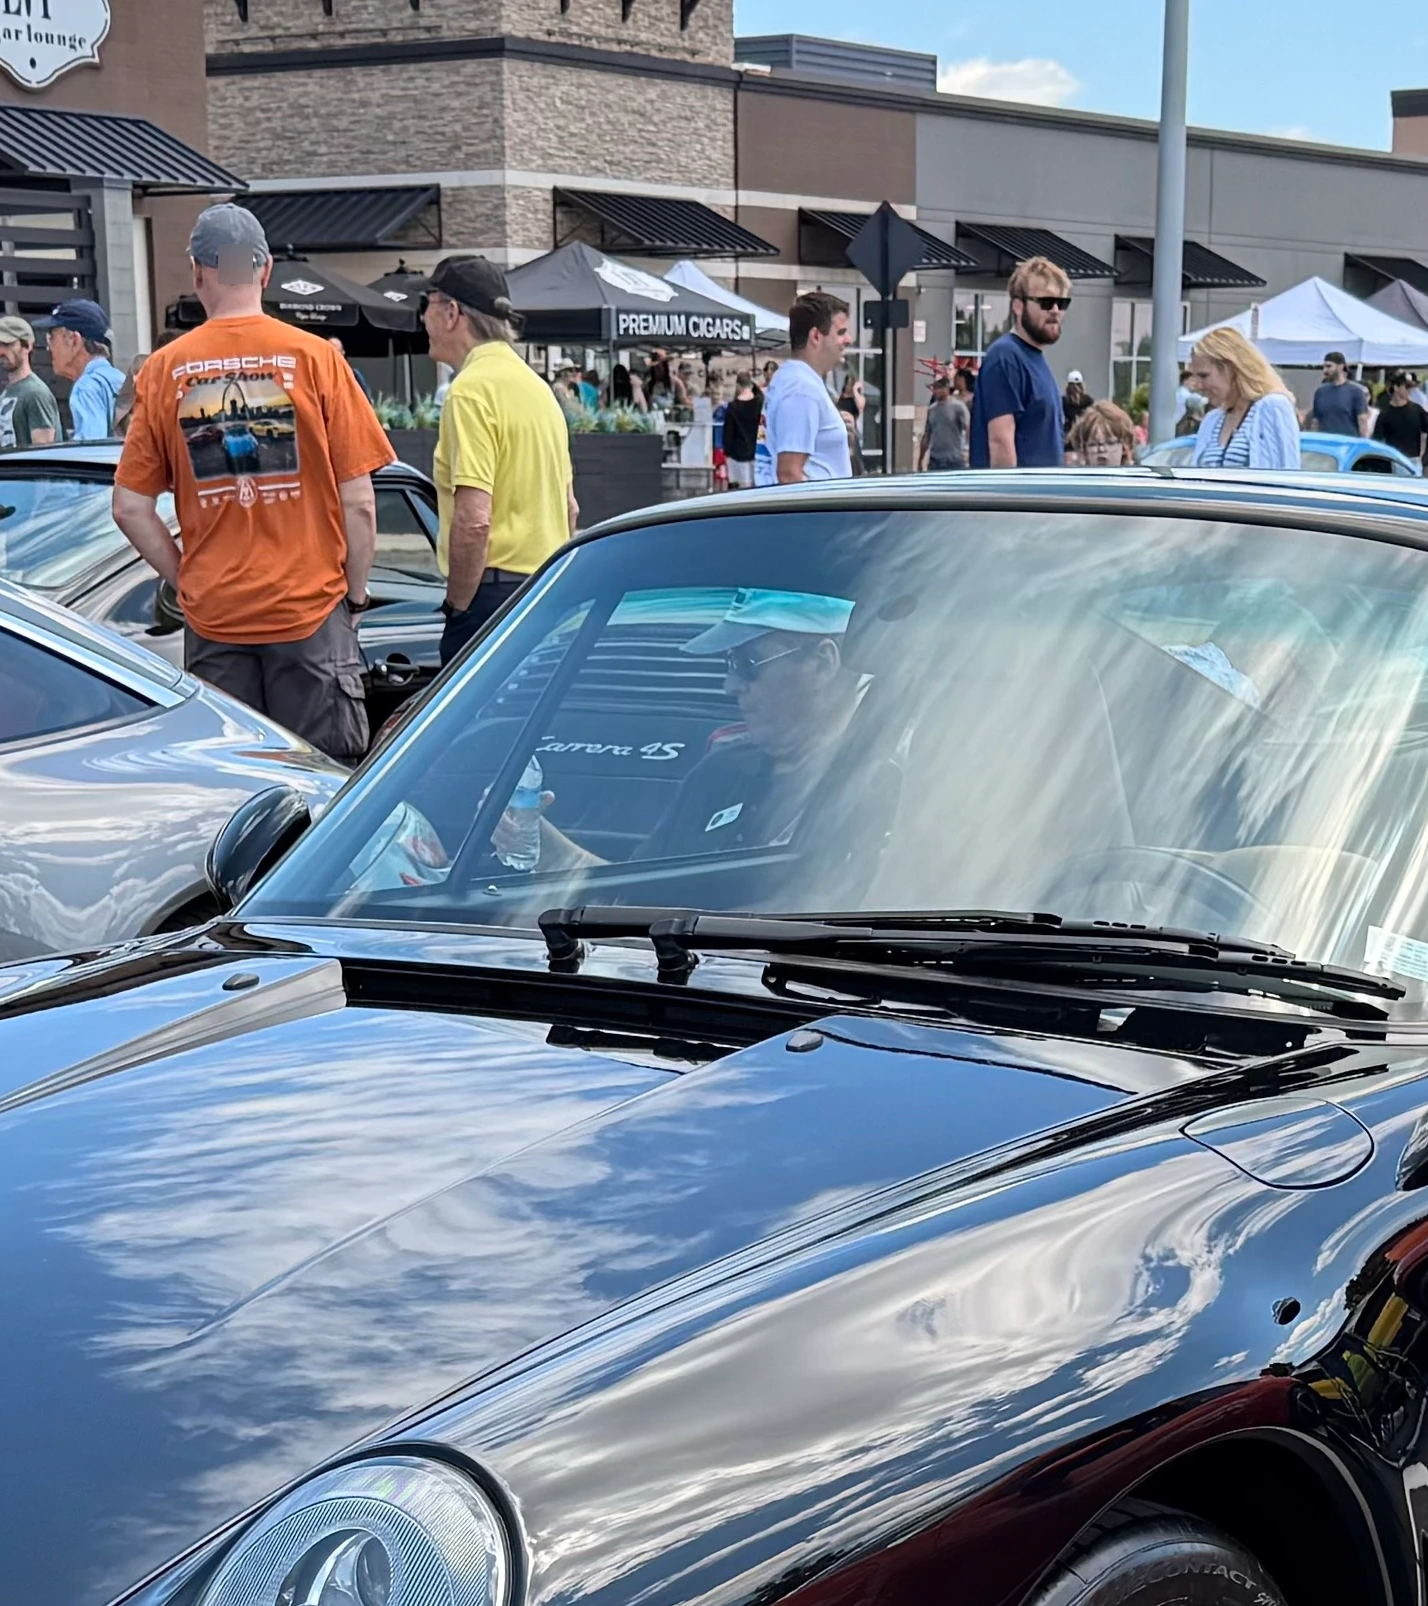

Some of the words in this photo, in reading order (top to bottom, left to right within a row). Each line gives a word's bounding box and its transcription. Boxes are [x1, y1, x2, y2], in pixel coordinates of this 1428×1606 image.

[27, 23, 87, 51] lounge
[619, 313, 687, 336] PREMIUM
[688, 316, 742, 340] CIGARS
